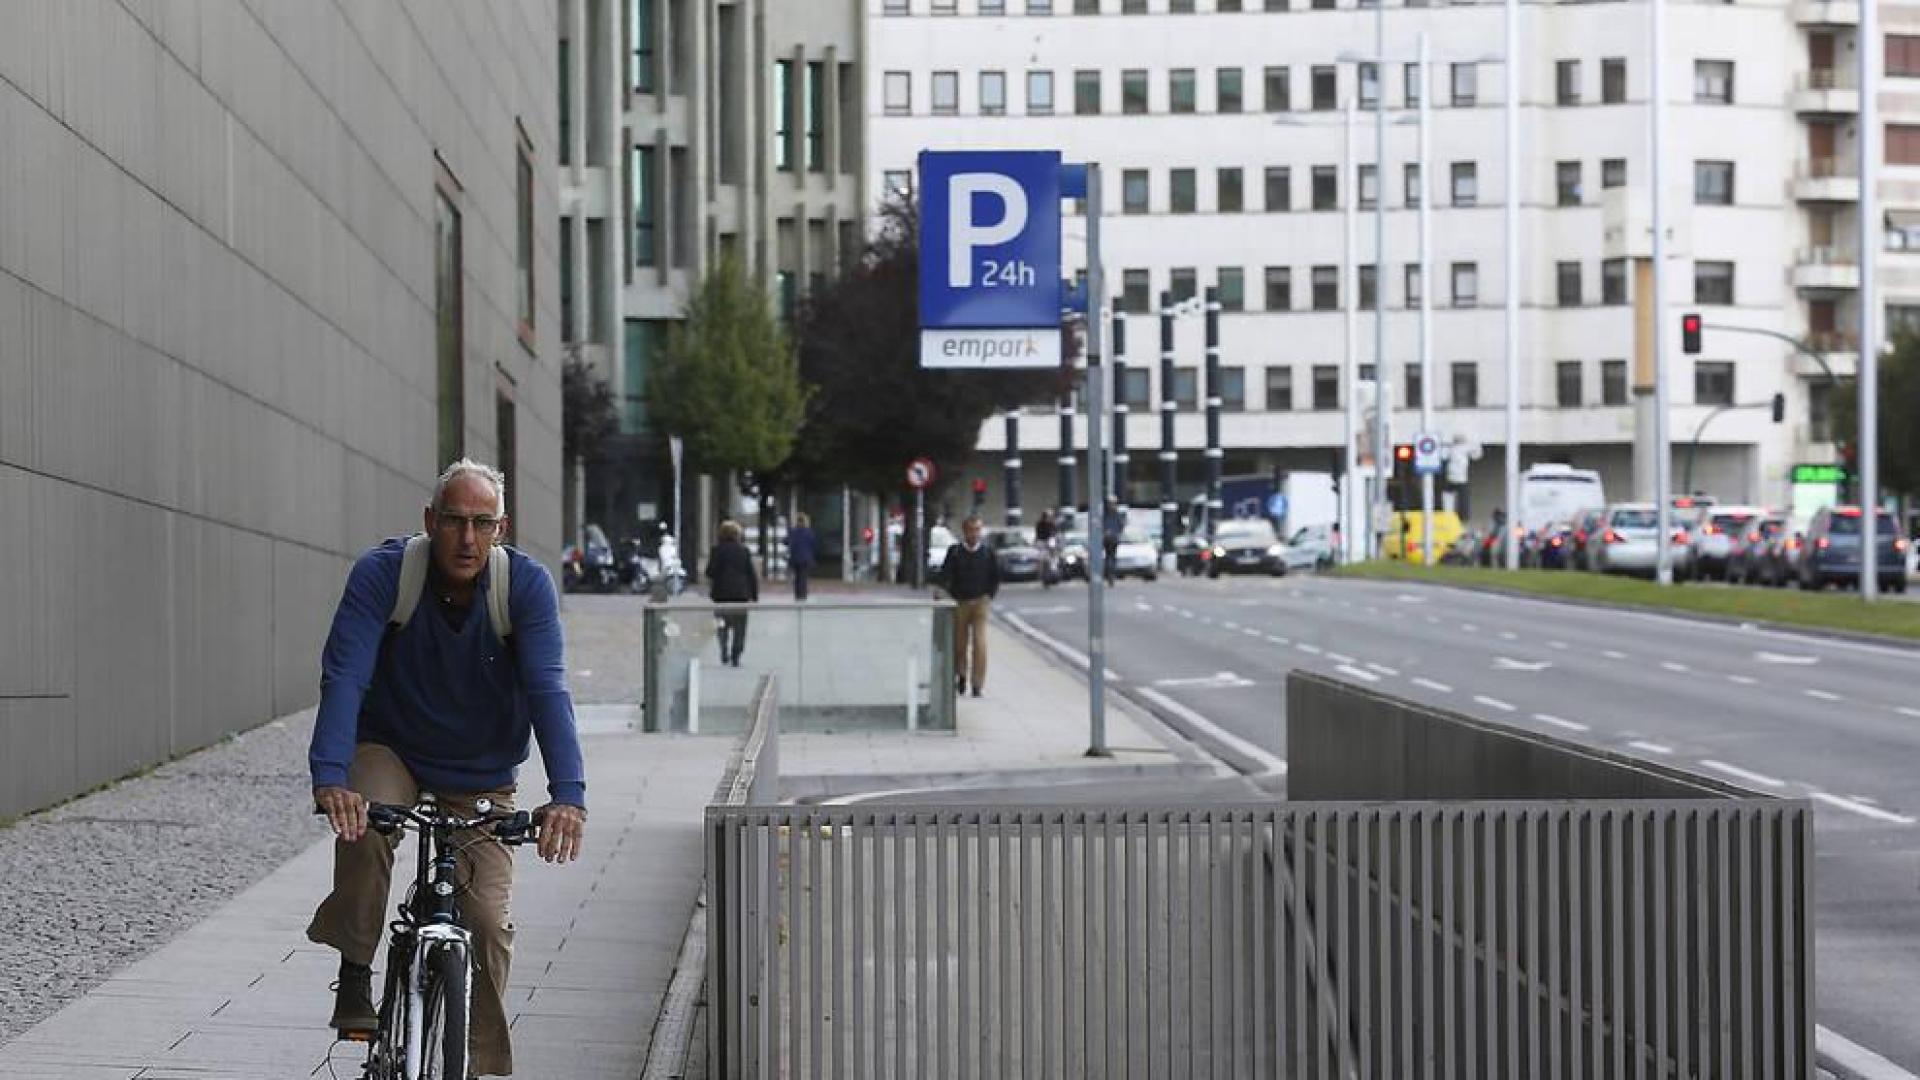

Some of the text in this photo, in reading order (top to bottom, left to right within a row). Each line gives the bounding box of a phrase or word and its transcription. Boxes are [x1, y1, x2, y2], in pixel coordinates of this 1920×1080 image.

[949, 172, 1028, 287] P
[981, 260, 1035, 286] 24h
[943, 335, 1039, 363] empark
